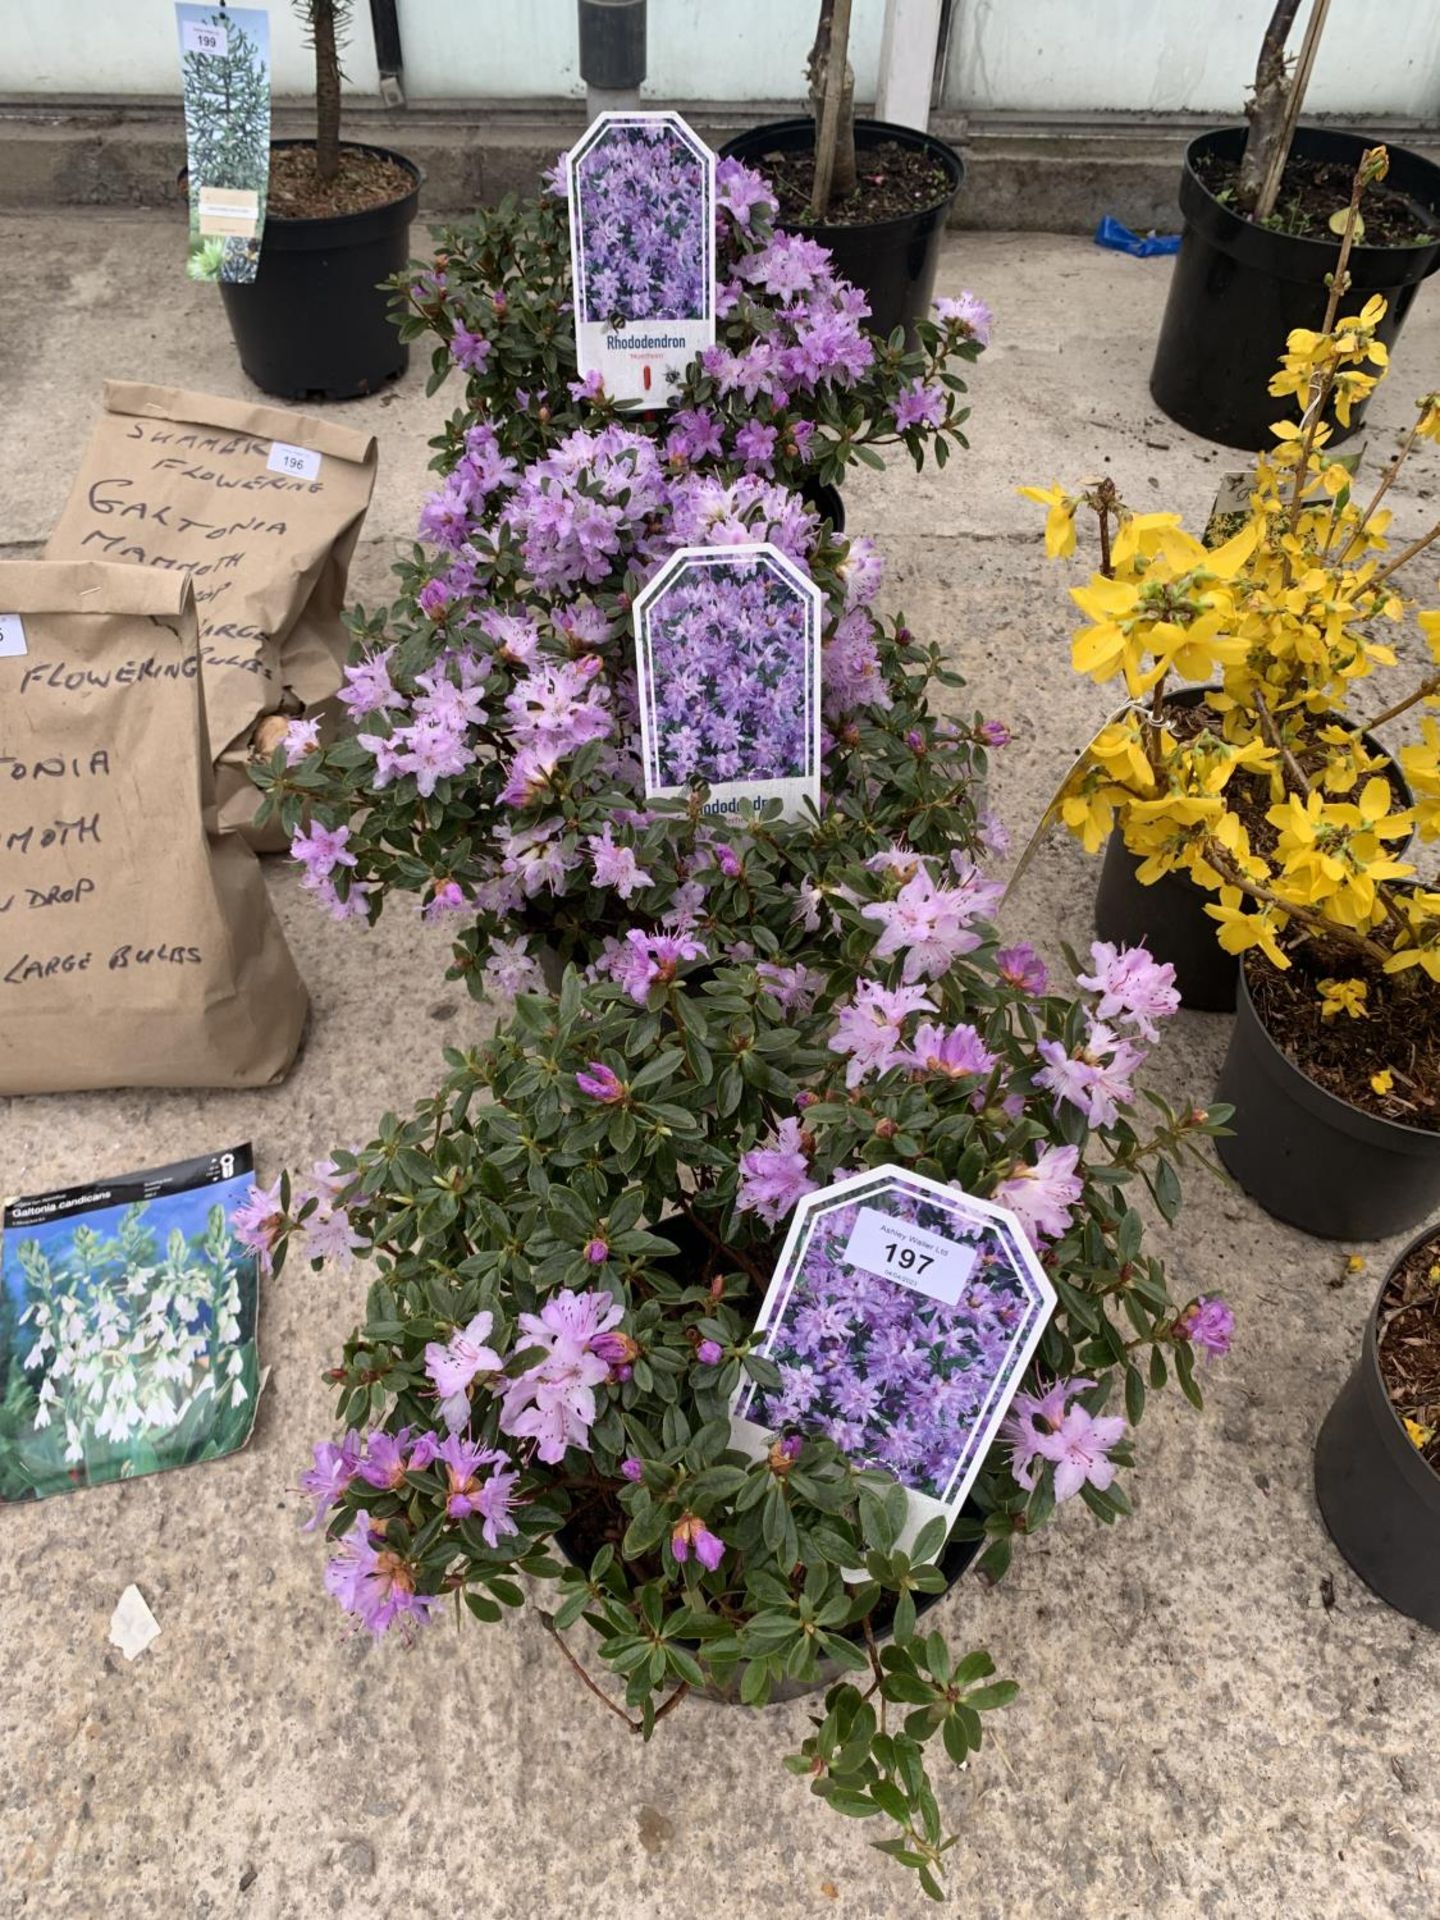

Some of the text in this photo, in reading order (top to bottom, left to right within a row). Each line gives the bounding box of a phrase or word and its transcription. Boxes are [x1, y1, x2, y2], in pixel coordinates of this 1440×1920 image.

[198, 35, 216, 48] 199
[606, 334, 686, 349] Rhododendron
[283, 455, 304, 471] 196
[81, 530, 245, 575] MAMMOTH
[20, 655, 198, 694] FLOWERING
[24, 877, 96, 909] DROP
[3, 944, 203, 984] LARGE BULBS
[12, 1202, 57, 1218] Galtonia
[57, 1190, 112, 1209] candicans
[885, 1243, 935, 1275] 197
